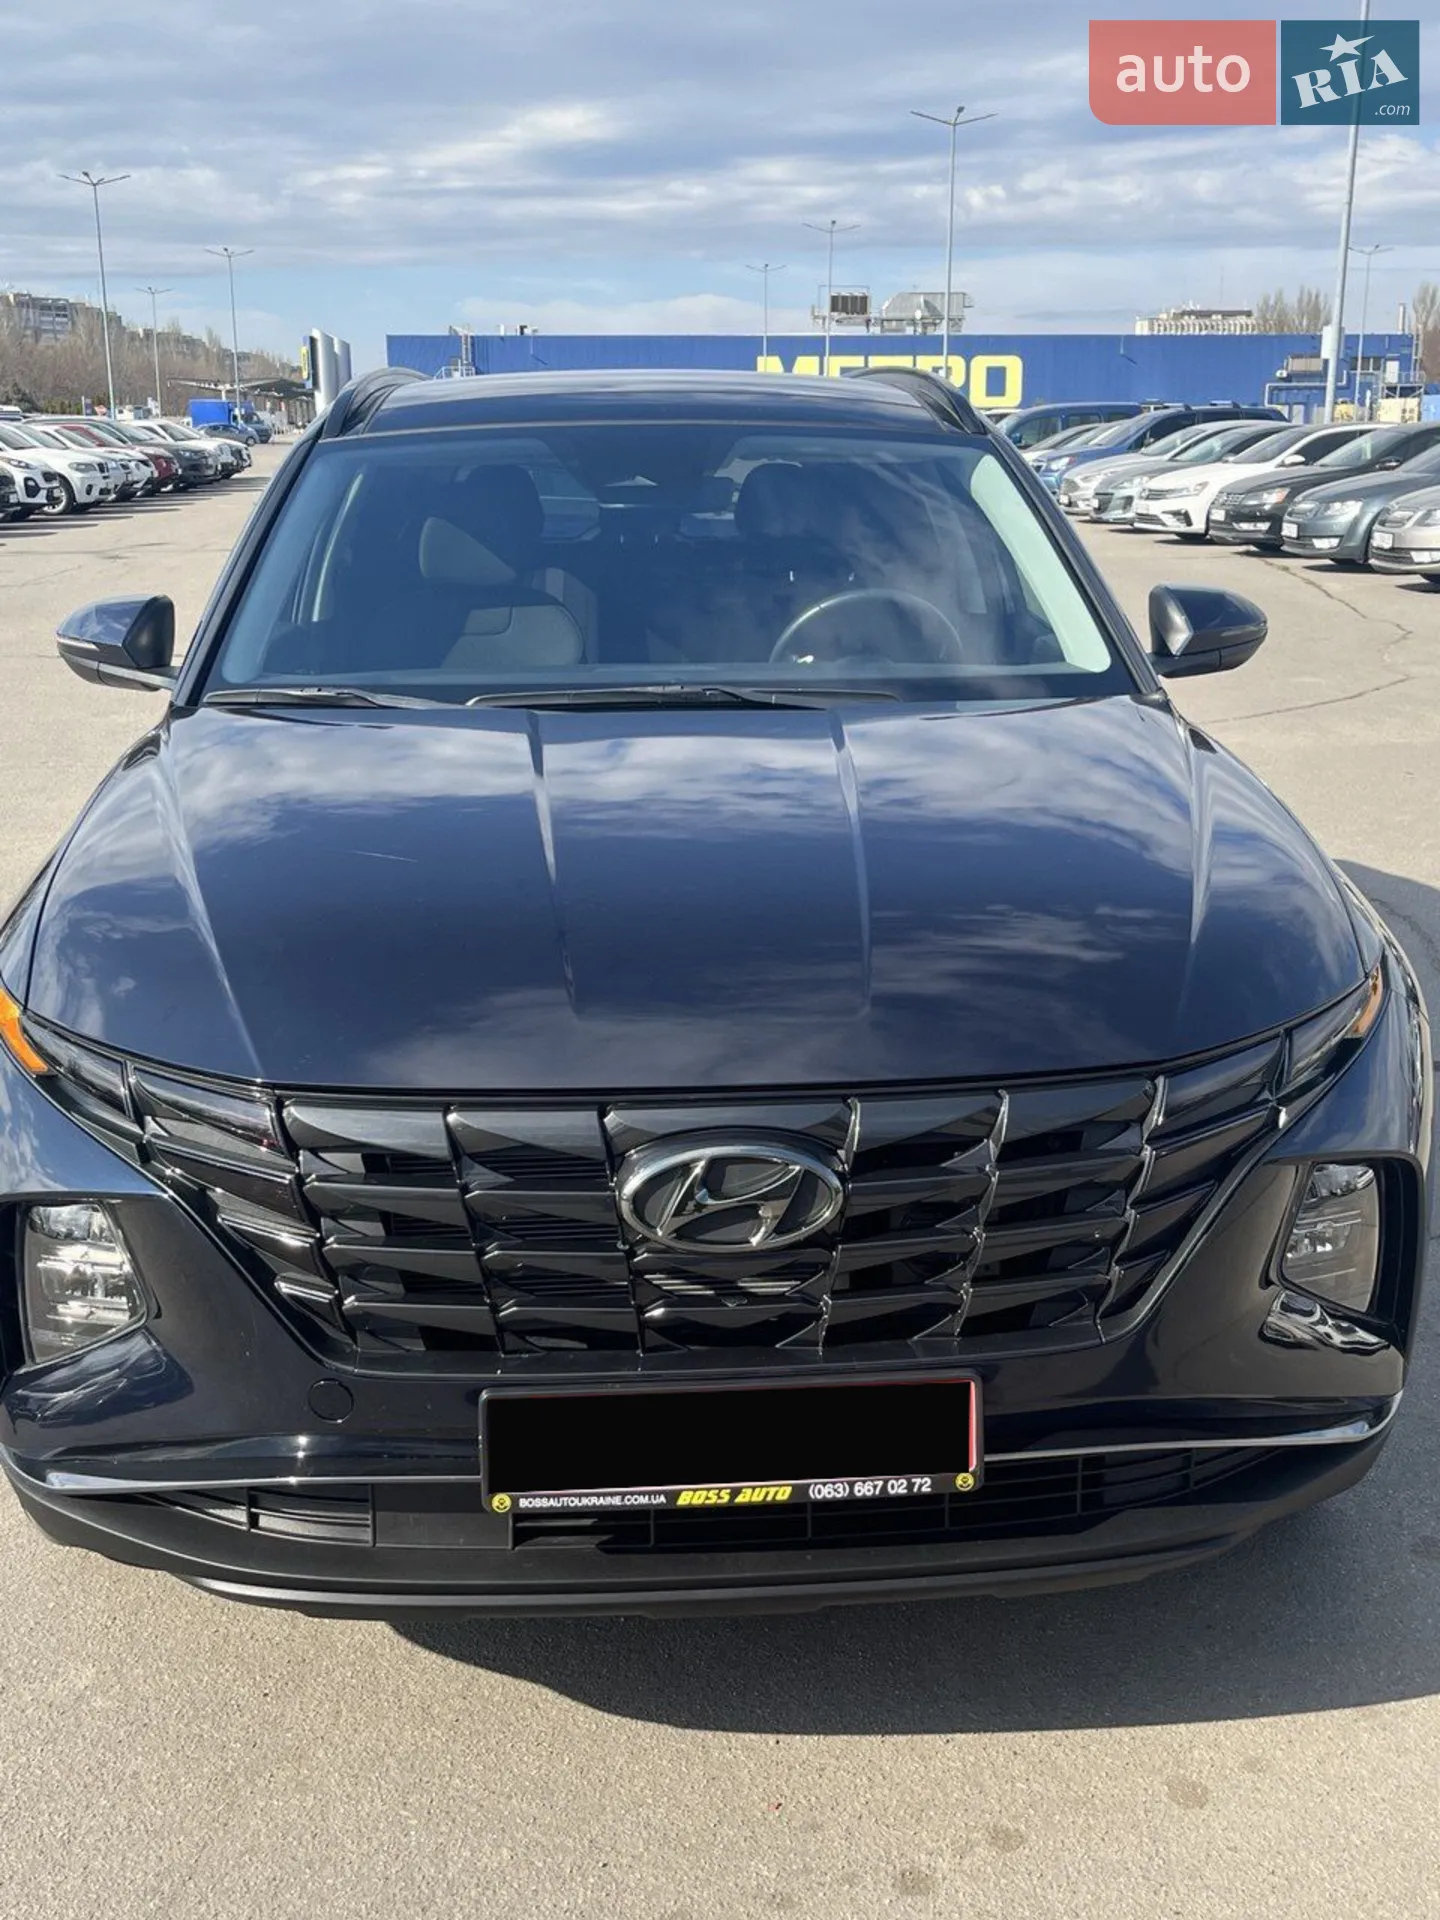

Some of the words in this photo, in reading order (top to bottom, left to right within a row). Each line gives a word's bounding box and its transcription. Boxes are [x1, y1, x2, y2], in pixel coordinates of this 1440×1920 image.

[518, 1494, 667, 1508] BOSSAUTOUKRAINE.COM.UA
[676, 1489, 731, 1506] BOSS
[735, 1485, 793, 1504] AUTO
[808, 1481, 850, 1500] (063)
[854, 1480, 883, 1497] 667
[887, 1478, 908, 1495] 02
[911, 1477, 932, 1493] 72
